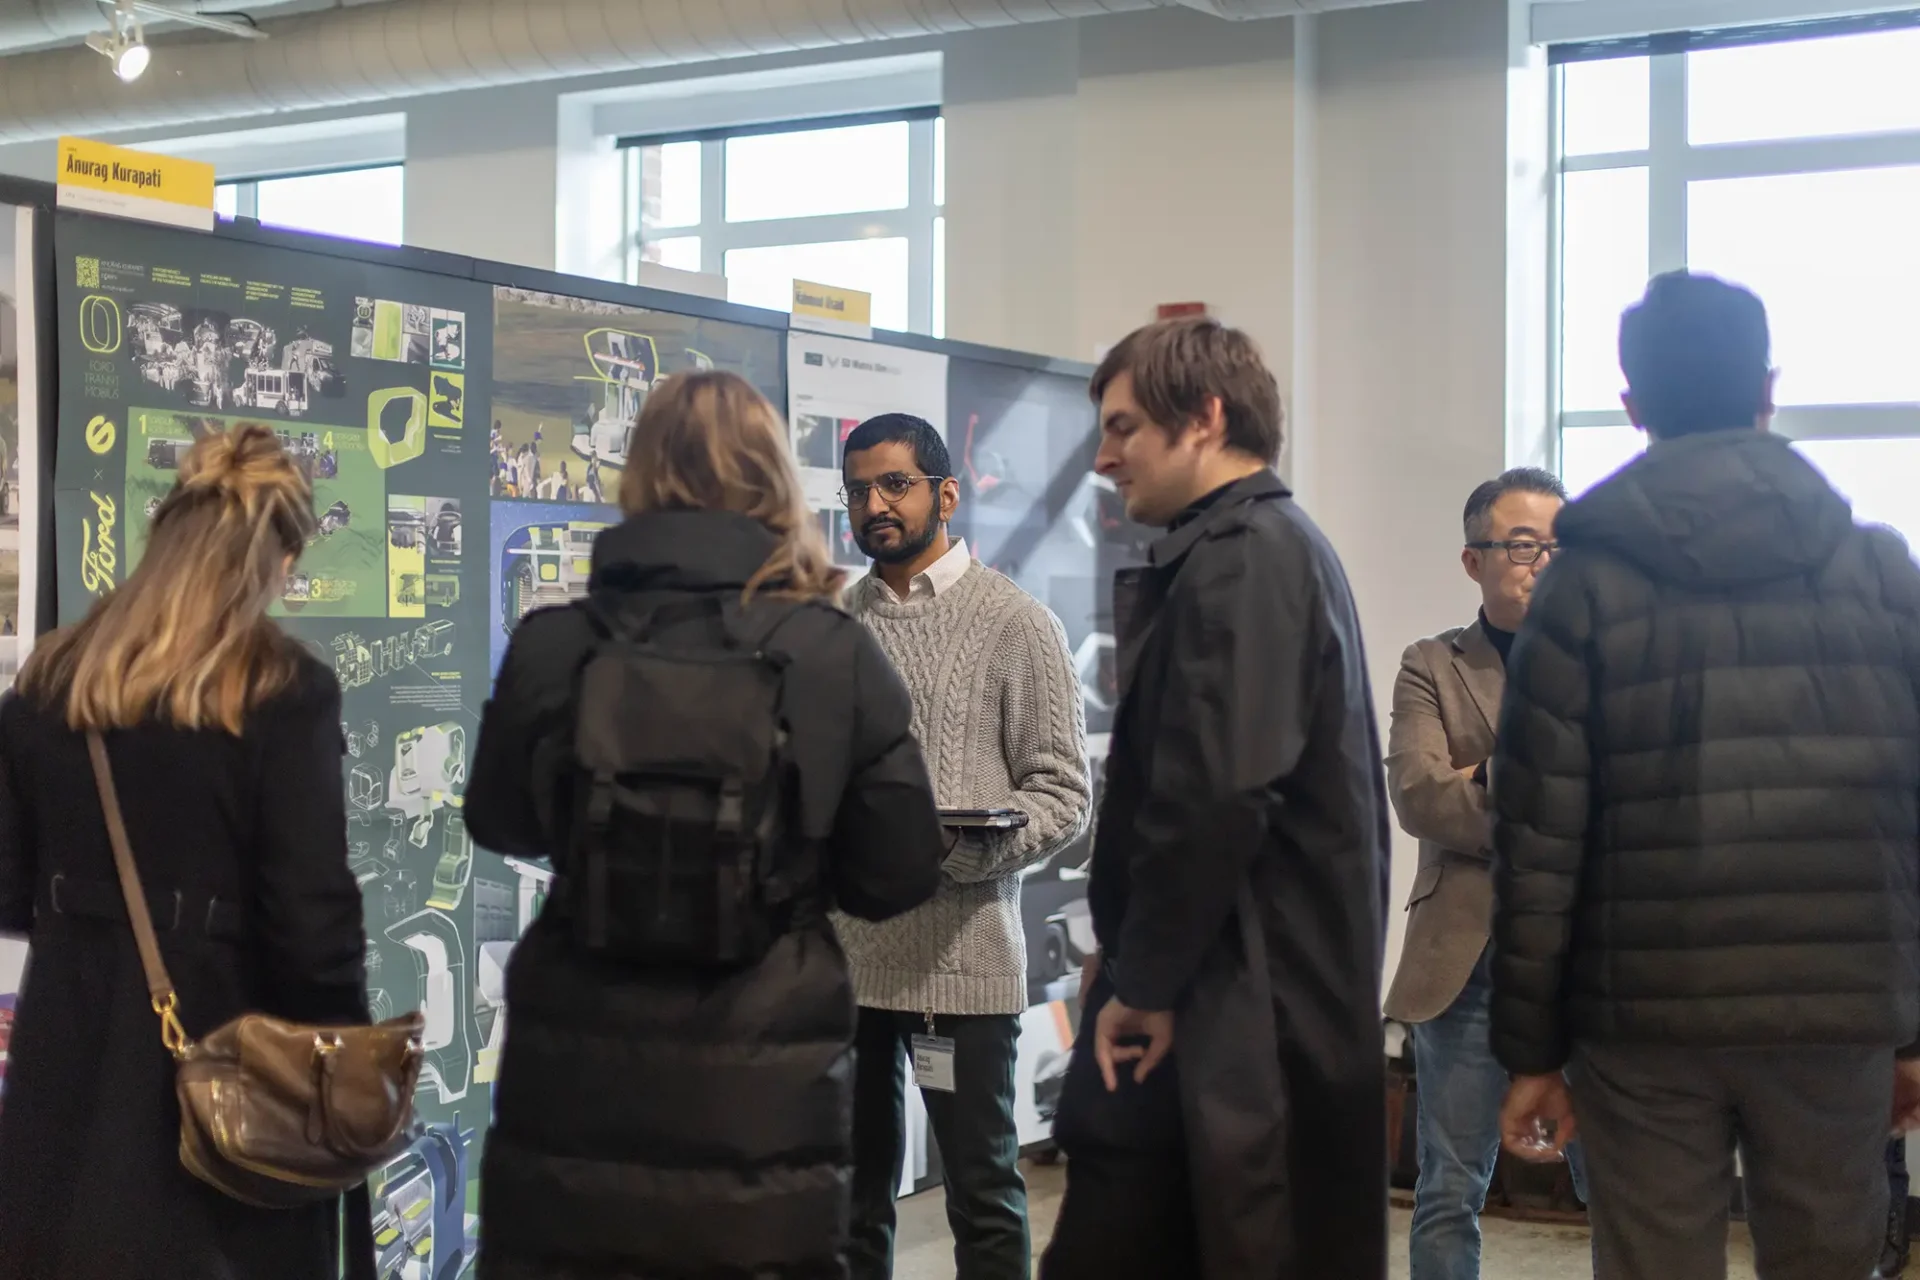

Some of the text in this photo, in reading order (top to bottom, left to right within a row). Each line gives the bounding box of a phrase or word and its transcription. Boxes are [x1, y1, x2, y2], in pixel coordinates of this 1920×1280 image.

[66, 153, 162, 189] Anurag Kurapati
[139, 414, 147, 435] 1
[323, 430, 334, 450] 4
[81, 490, 116, 598] Ford
[311, 578, 321, 599] 3
